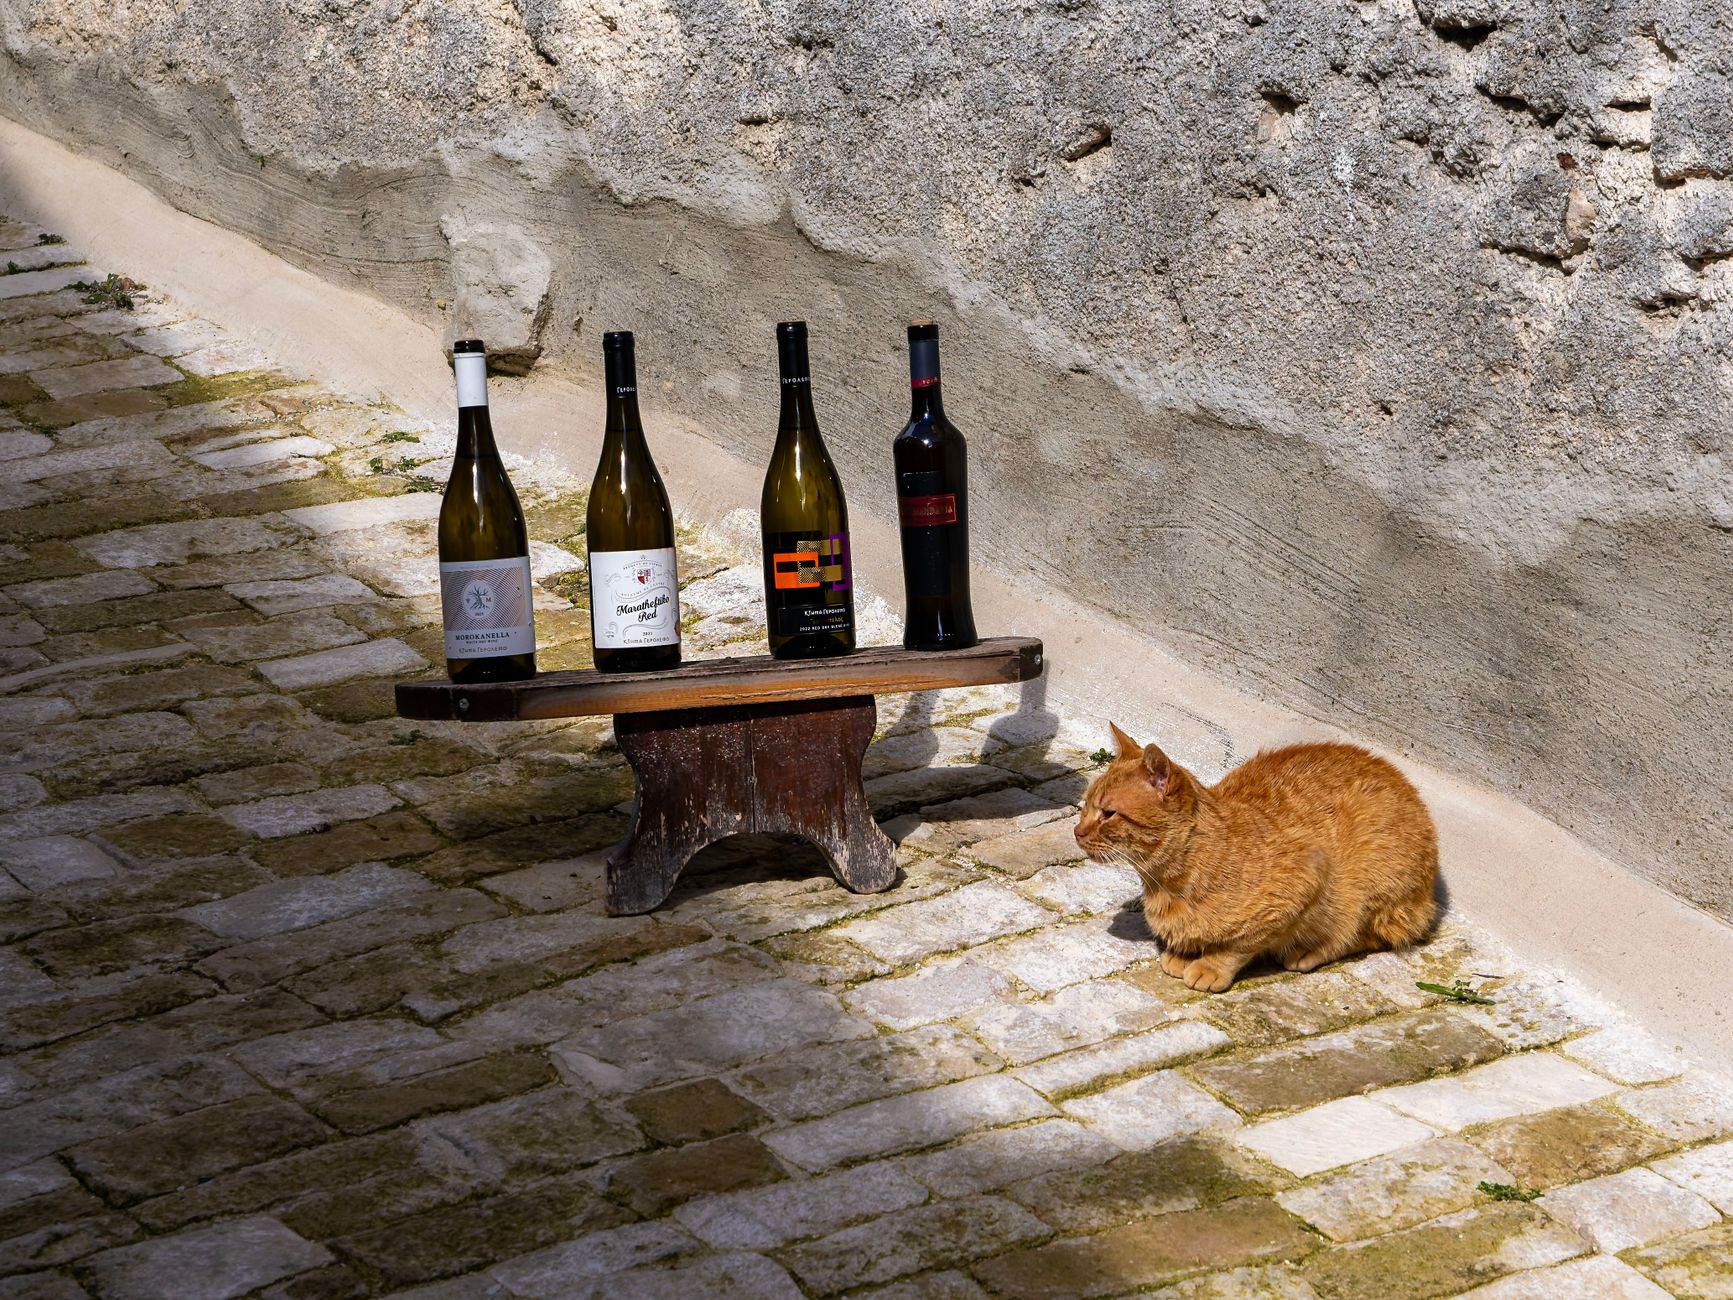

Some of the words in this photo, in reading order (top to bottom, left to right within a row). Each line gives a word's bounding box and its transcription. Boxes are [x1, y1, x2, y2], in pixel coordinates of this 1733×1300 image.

[616, 593, 670, 616] Maratheftiko
[638, 609, 657, 622] Red
[455, 632, 510, 640] MOROKANELLA
